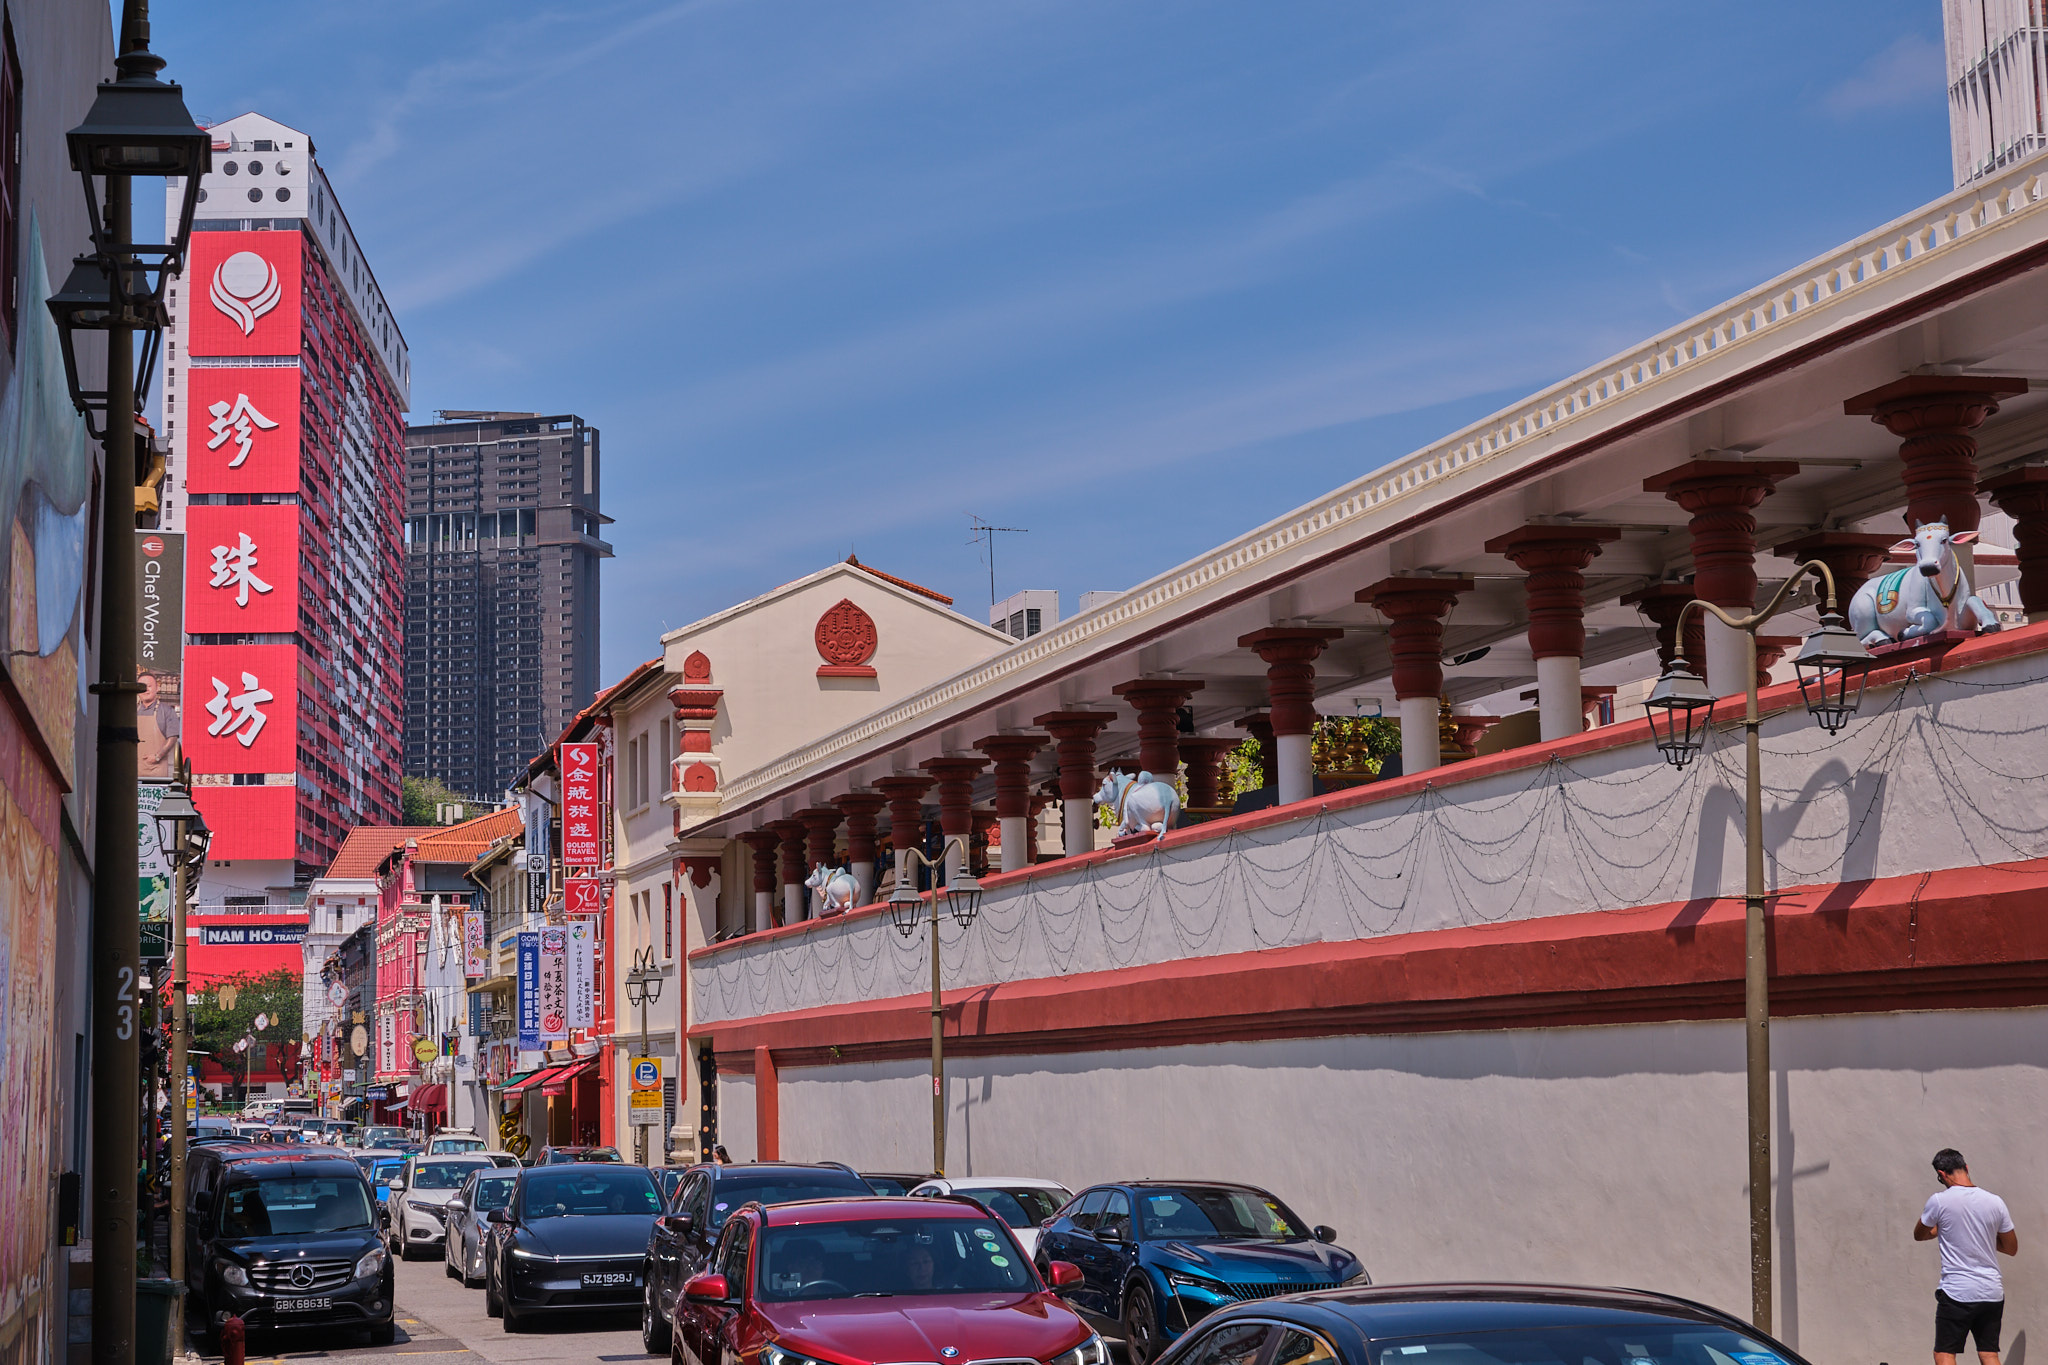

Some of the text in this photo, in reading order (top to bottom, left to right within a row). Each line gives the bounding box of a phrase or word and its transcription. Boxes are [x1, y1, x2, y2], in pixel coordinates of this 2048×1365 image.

[205, 393, 279, 747] 珍珠坊
[142, 560, 160, 658] Chef Works
[138, 803, 159, 812] RIEN
[565, 880, 598, 912] 50
[138, 923, 160, 932] ANG
[208, 929, 305, 942] NAM HO TRAVE
[583, 1273, 633, 1284] SJZ1929J
[275, 1297, 331, 1310] GBK6863E
